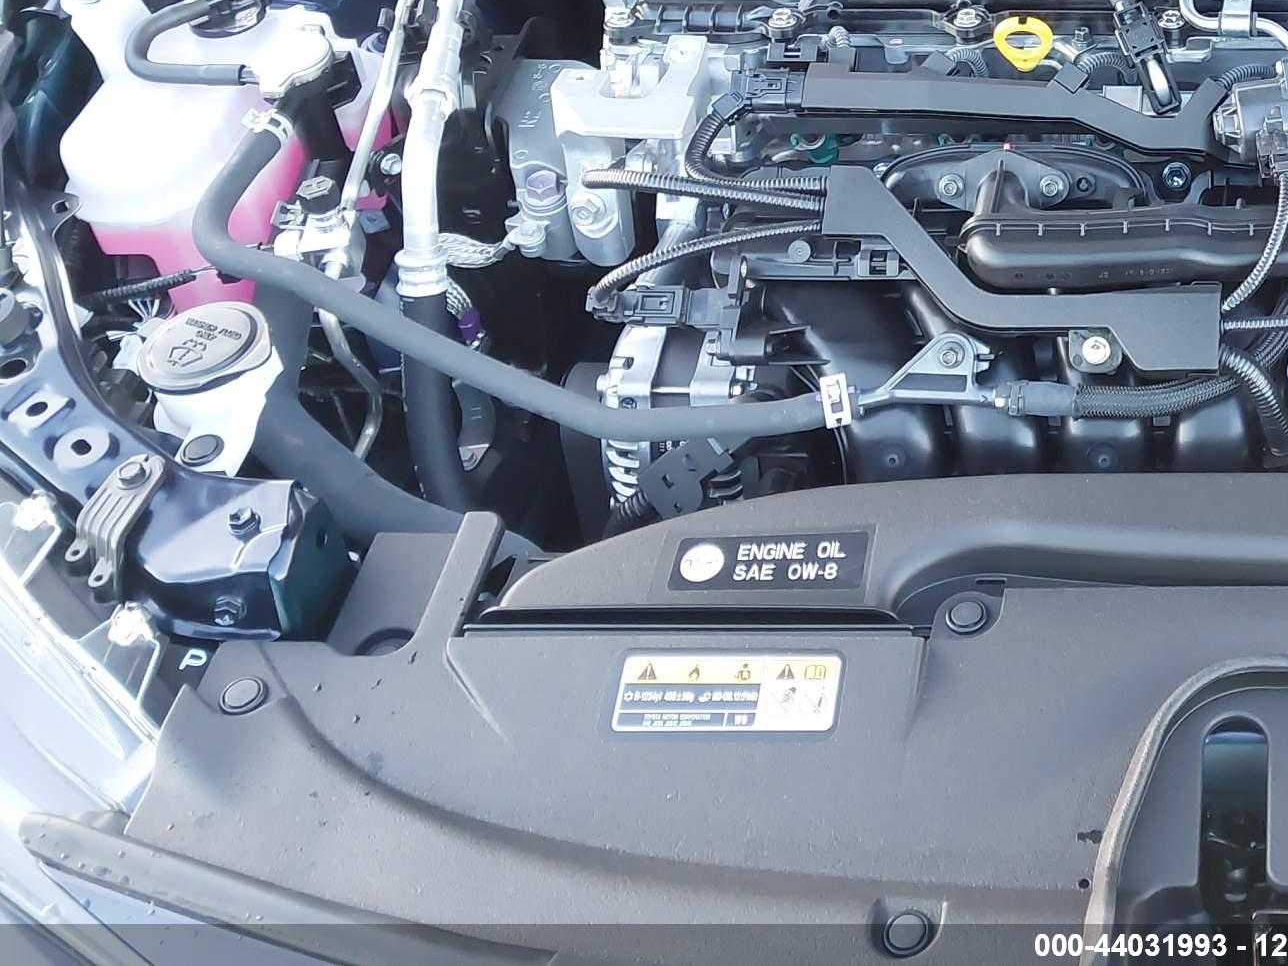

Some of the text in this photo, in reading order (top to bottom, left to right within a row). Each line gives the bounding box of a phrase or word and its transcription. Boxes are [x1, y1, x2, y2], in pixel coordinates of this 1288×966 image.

[737, 540, 847, 561] ENGINE OIL
[733, 563, 776, 581] SAE
[179, 648, 207, 670] P
